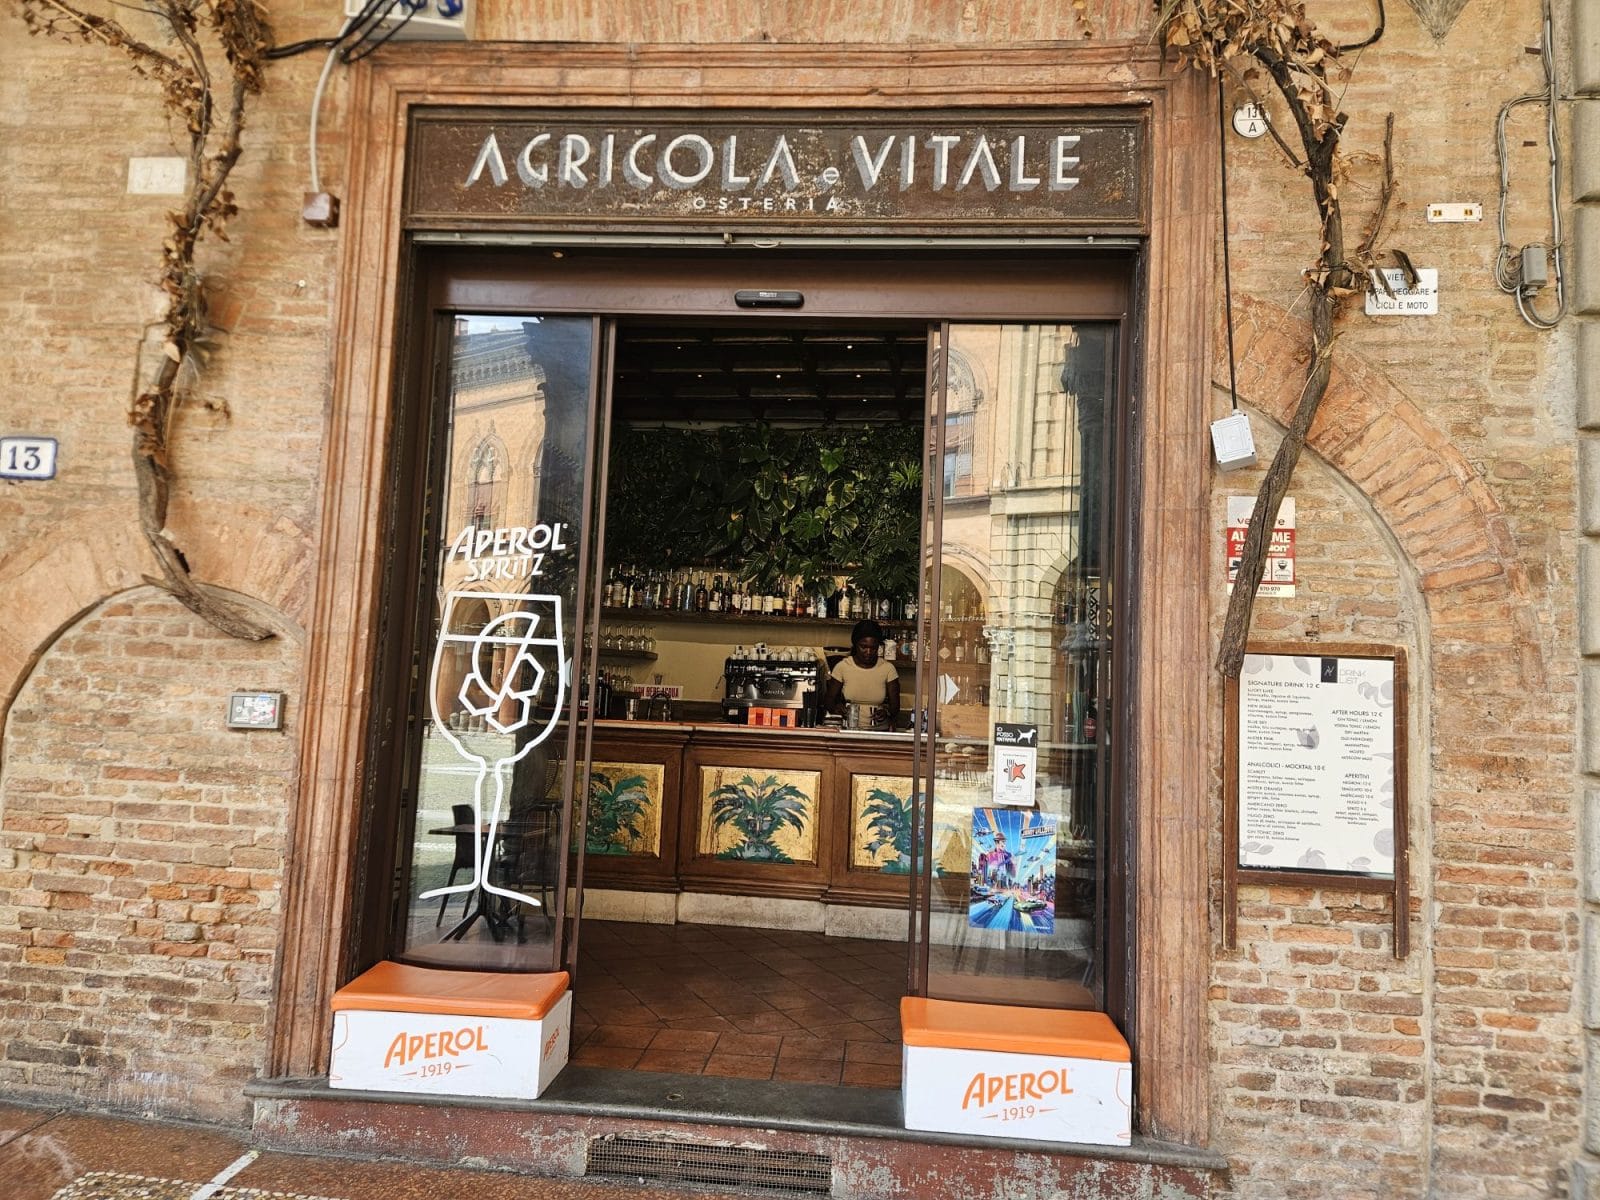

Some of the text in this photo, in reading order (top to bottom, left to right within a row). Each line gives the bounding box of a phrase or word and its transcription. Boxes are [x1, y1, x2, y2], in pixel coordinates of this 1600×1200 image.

[1248, 122, 1257, 133] A
[467, 133, 803, 190] AGRICOLA
[850, 135, 1081, 191] VITALE
[692, 195, 842, 212] OSTERIA
[1376, 301, 1429, 310] CICLI E MOTO
[8, 446, 41, 471] 13
[446, 522, 567, 564] APEROL
[383, 1026, 489, 1068] APEROL
[420, 1062, 452, 1078] 1919
[962, 1068, 1074, 1110] APEROL
[1001, 1105, 1036, 1121] 1919
